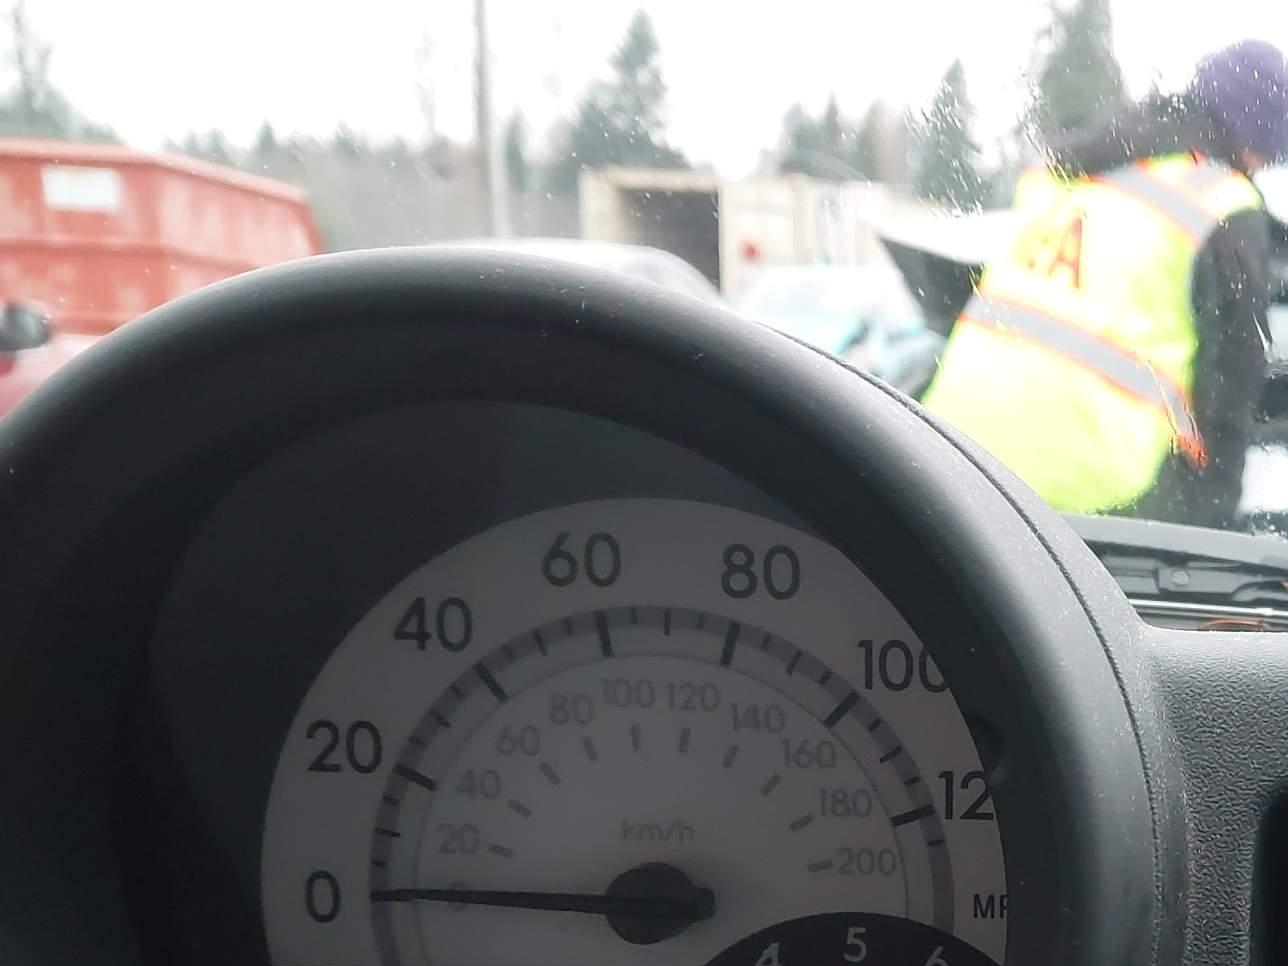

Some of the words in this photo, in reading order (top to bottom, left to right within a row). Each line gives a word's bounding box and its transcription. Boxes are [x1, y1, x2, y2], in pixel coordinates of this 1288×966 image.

[542, 533, 621, 587] 60
[721, 544, 799, 600] 80
[394, 598, 472, 651] 40
[601, 678, 655, 708] 100
[668, 682, 720, 712] 120
[549, 694, 594, 725] 80
[730, 704, 786, 733] 140
[306, 720, 383, 774] 20
[496, 725, 541, 756] 60
[782, 739, 836, 768] 160
[456, 769, 501, 799] 40
[938, 771, 994, 821] 12
[818, 789, 872, 818] 180
[435, 823, 480, 854] 20
[622, 818, 695, 841] km/h
[836, 848, 897, 876] 200
[305, 870, 341, 922] 0
[843, 927, 867, 962] 5
